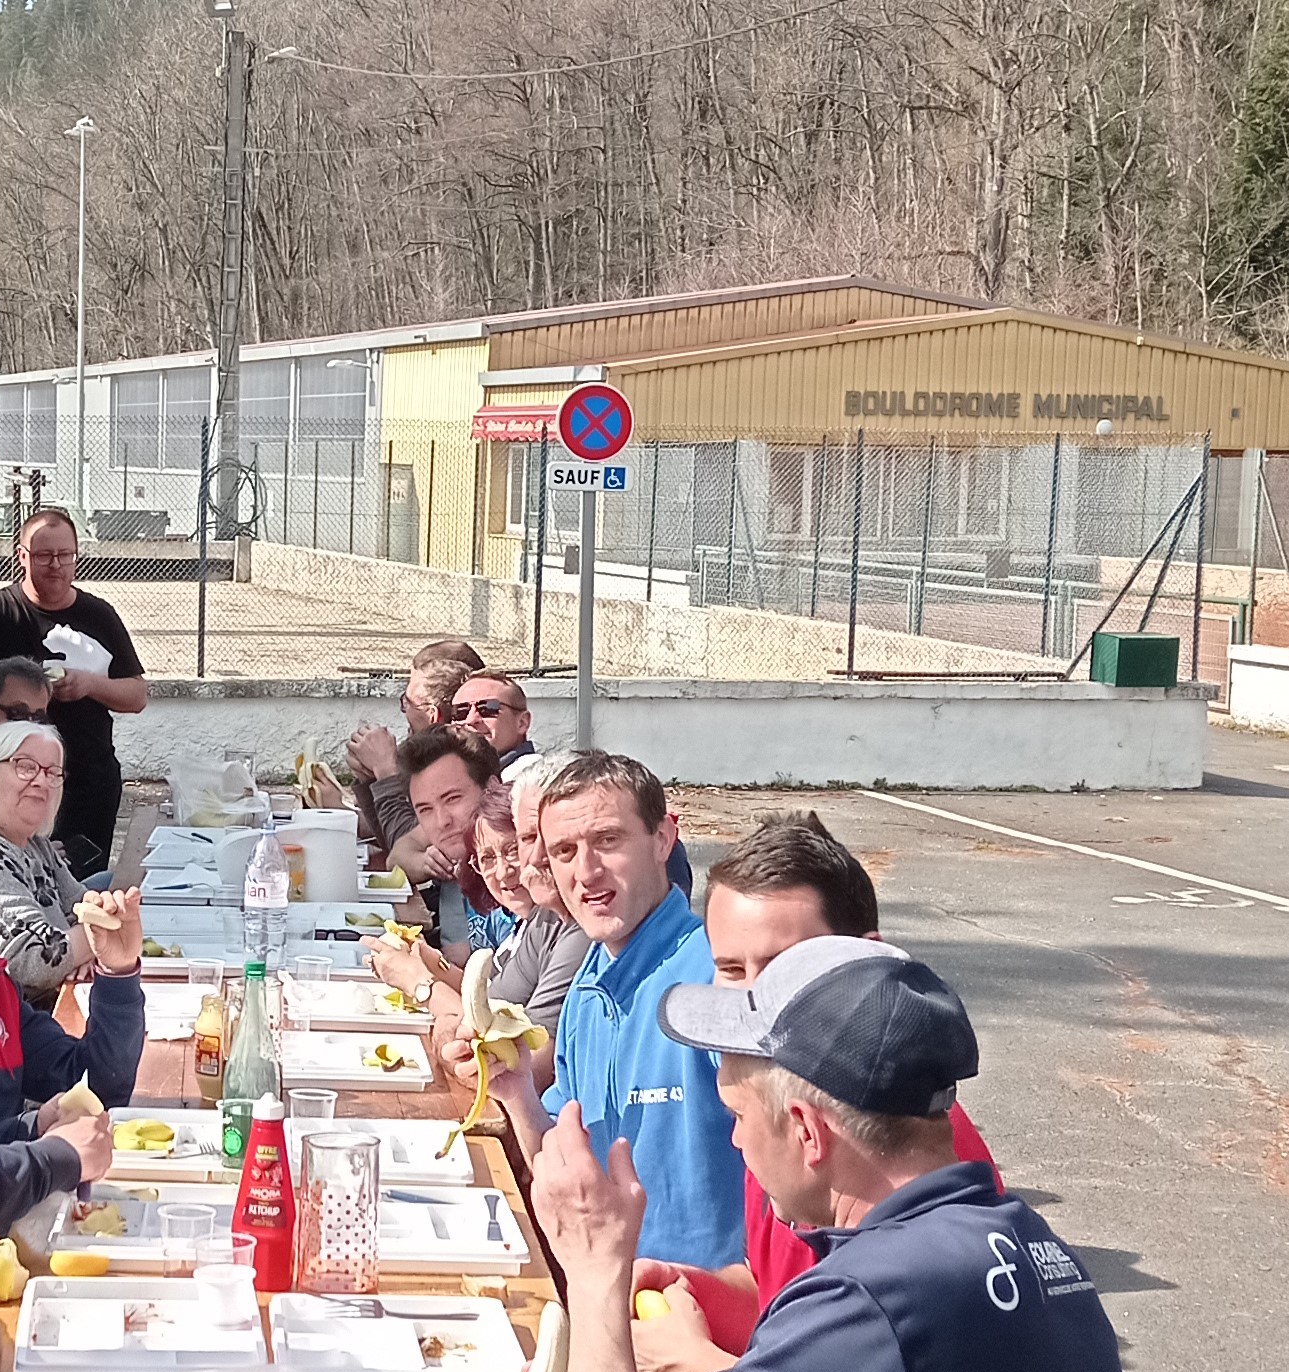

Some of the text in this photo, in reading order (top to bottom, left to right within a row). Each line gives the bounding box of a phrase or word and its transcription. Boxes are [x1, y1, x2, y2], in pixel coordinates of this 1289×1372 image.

[844, 390, 1170, 421] BOULODROME MUNICIPAL
[553, 468, 601, 486] SAUF
